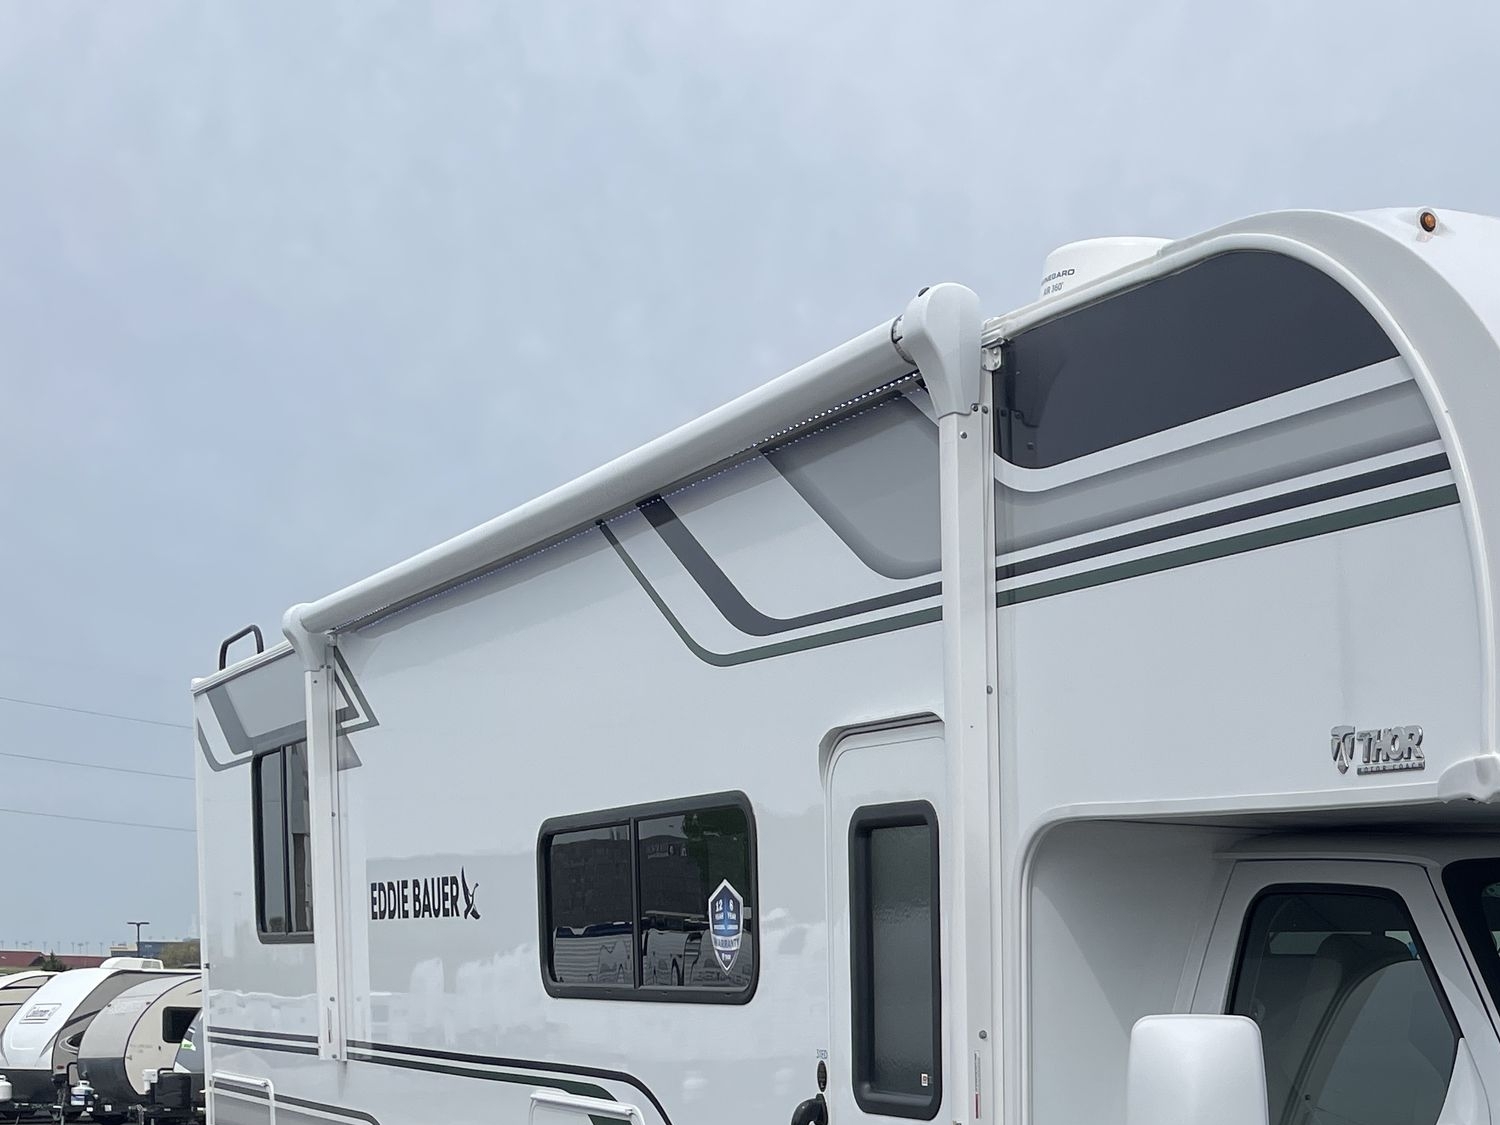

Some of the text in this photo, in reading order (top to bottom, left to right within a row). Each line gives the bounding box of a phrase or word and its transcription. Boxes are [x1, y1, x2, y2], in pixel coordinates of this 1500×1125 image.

[1356, 725, 1425, 764] THOR
[371, 876, 460, 920] EDDIE BAUER
[715, 899, 723, 913] 12
[729, 899, 734, 912] 6
